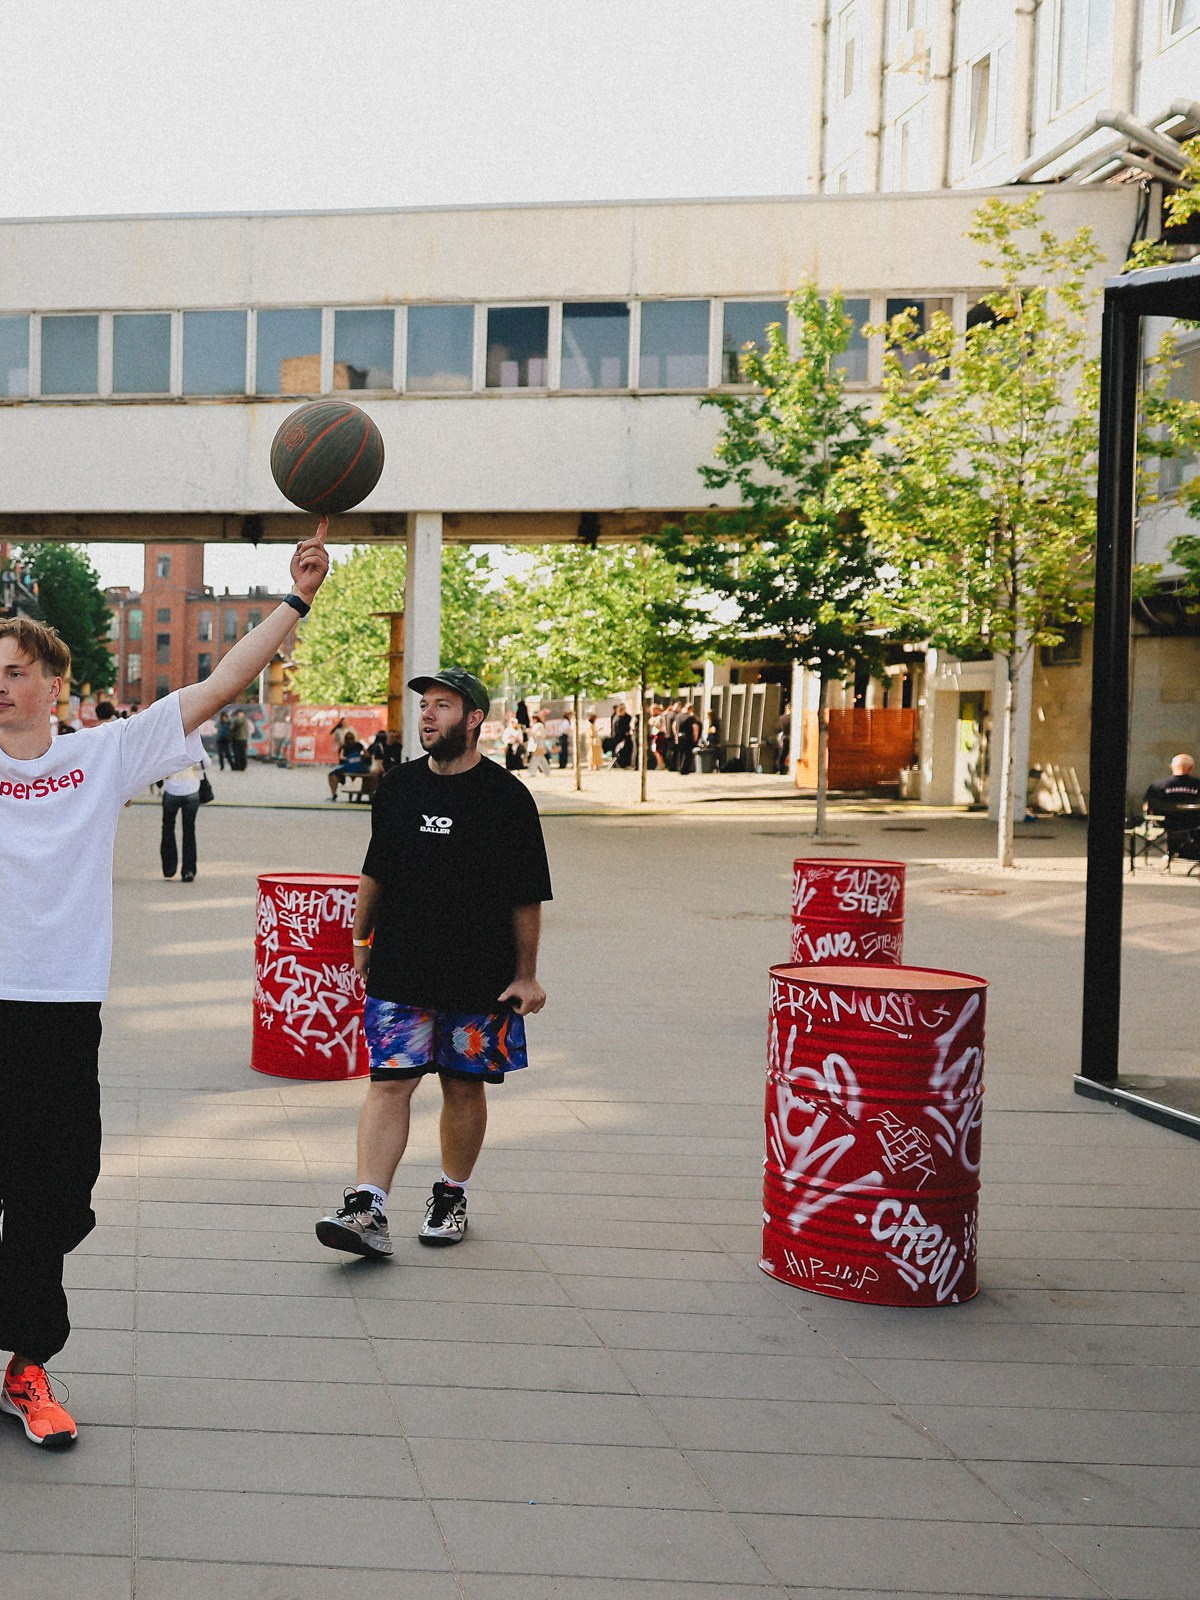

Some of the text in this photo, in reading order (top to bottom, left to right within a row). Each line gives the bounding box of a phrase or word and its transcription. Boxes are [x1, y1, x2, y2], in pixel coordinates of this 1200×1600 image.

[421, 814, 453, 828] YO
[419, 826, 451, 835] BALLER
[321, 887, 358, 928] CRE
